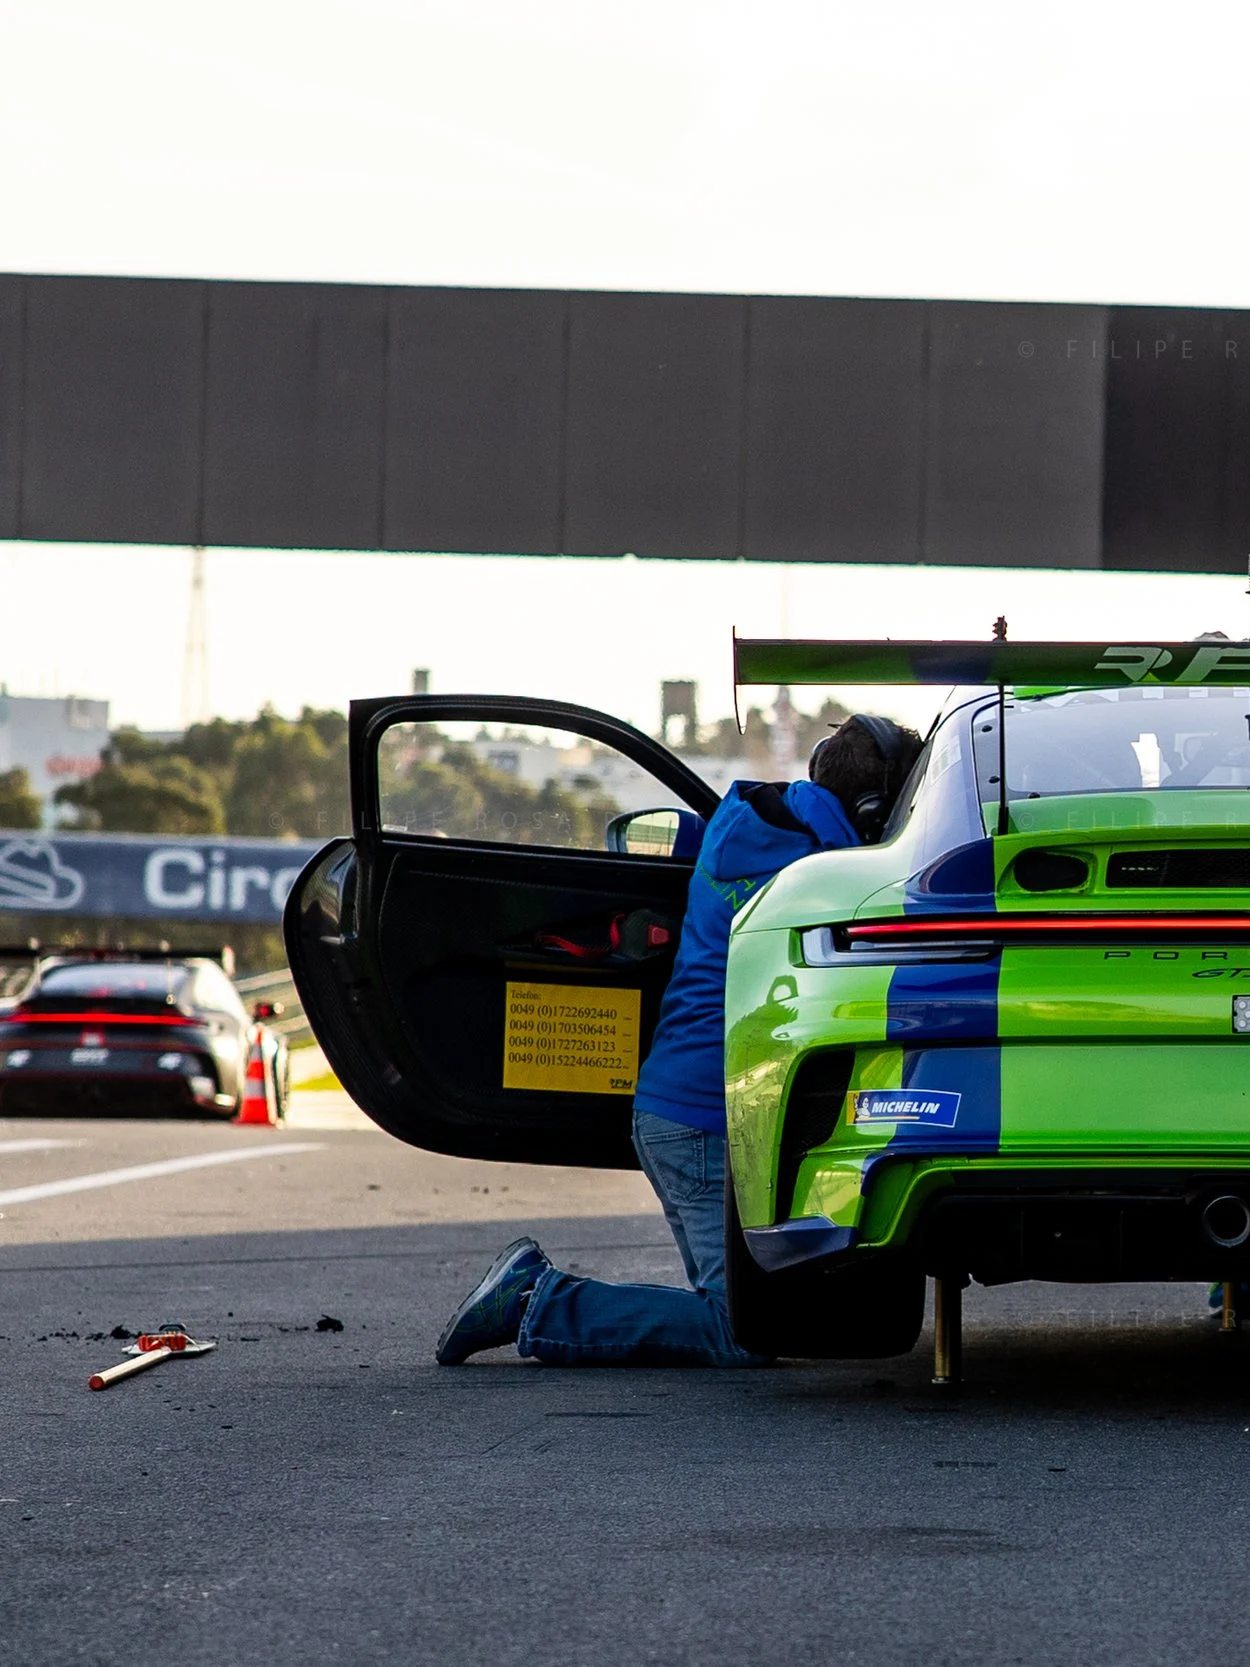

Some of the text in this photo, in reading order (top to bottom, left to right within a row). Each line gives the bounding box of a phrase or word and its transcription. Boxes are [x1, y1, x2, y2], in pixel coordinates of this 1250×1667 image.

[510, 1003, 535, 1016] 0049
[509, 1020, 534, 1032] 0049
[508, 1036, 534, 1048] 0049
[508, 1052, 533, 1065] 0049
[871, 1101, 940, 1114] MICHELIN
